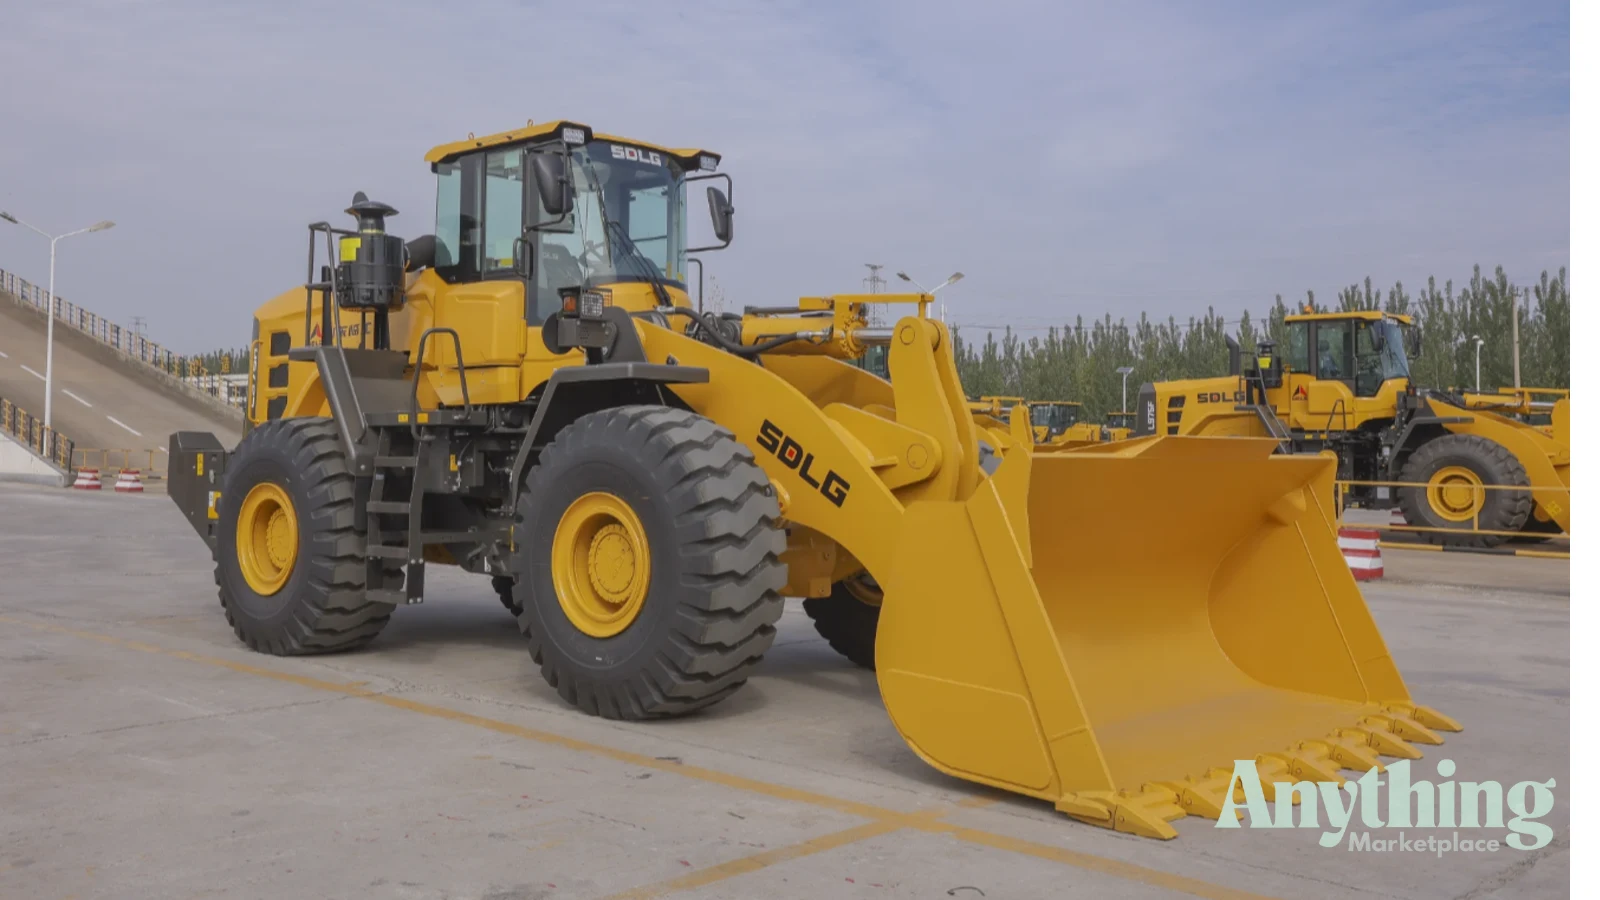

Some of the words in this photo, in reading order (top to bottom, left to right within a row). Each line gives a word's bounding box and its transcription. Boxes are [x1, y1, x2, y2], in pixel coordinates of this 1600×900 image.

[610, 144, 662, 167] SDLG
[1197, 391, 1246, 404] SDLG
[756, 418, 851, 509] SDLG
